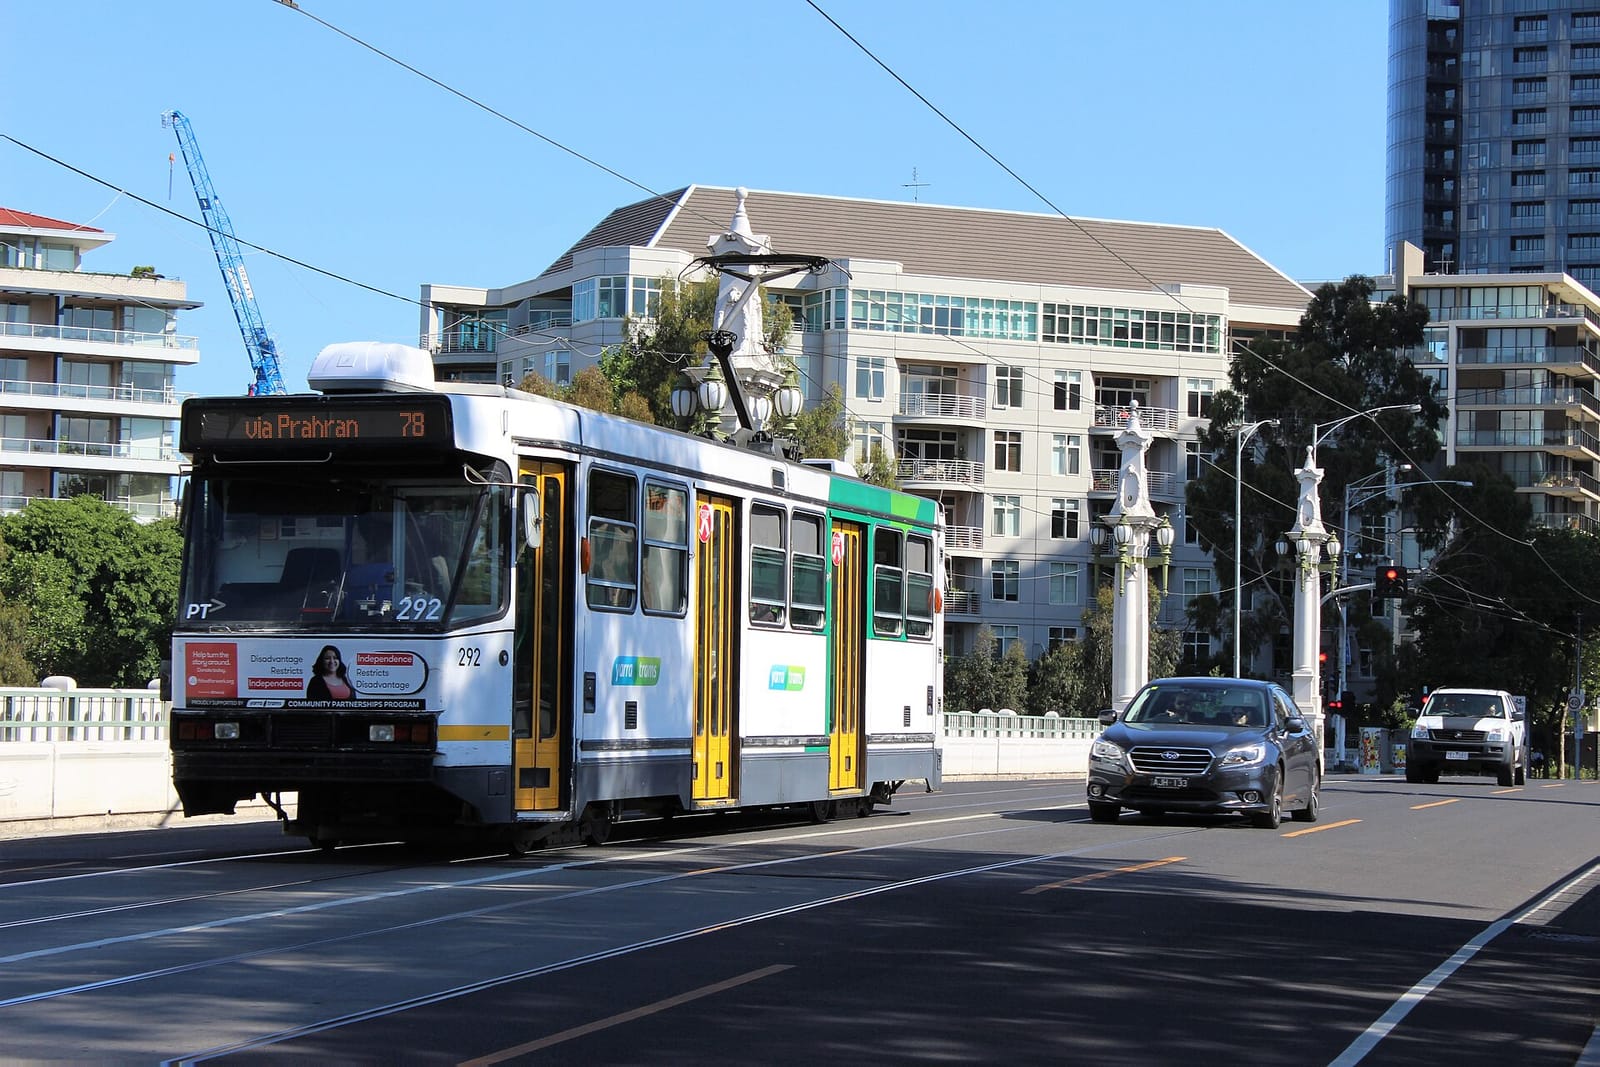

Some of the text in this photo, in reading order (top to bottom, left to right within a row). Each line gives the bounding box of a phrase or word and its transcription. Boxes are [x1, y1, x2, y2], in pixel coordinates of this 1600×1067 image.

[245, 414, 359, 439] via Prahran
[399, 412, 425, 437] 78
[396, 598, 442, 621] 292
[250, 654, 304, 665] Disadvantage
[357, 655, 413, 665] Independence
[458, 647, 481, 667] 292
[271, 666, 304, 675] Restricts
[356, 668, 389, 677] Restricts
[615, 661, 657, 682] yarra trams
[248, 679, 303, 689] Independence
[356, 680, 410, 690] Disadvantage
[331, 700, 383, 708] PARTNERSHIPS
[384, 700, 419, 708] PROGRAM
